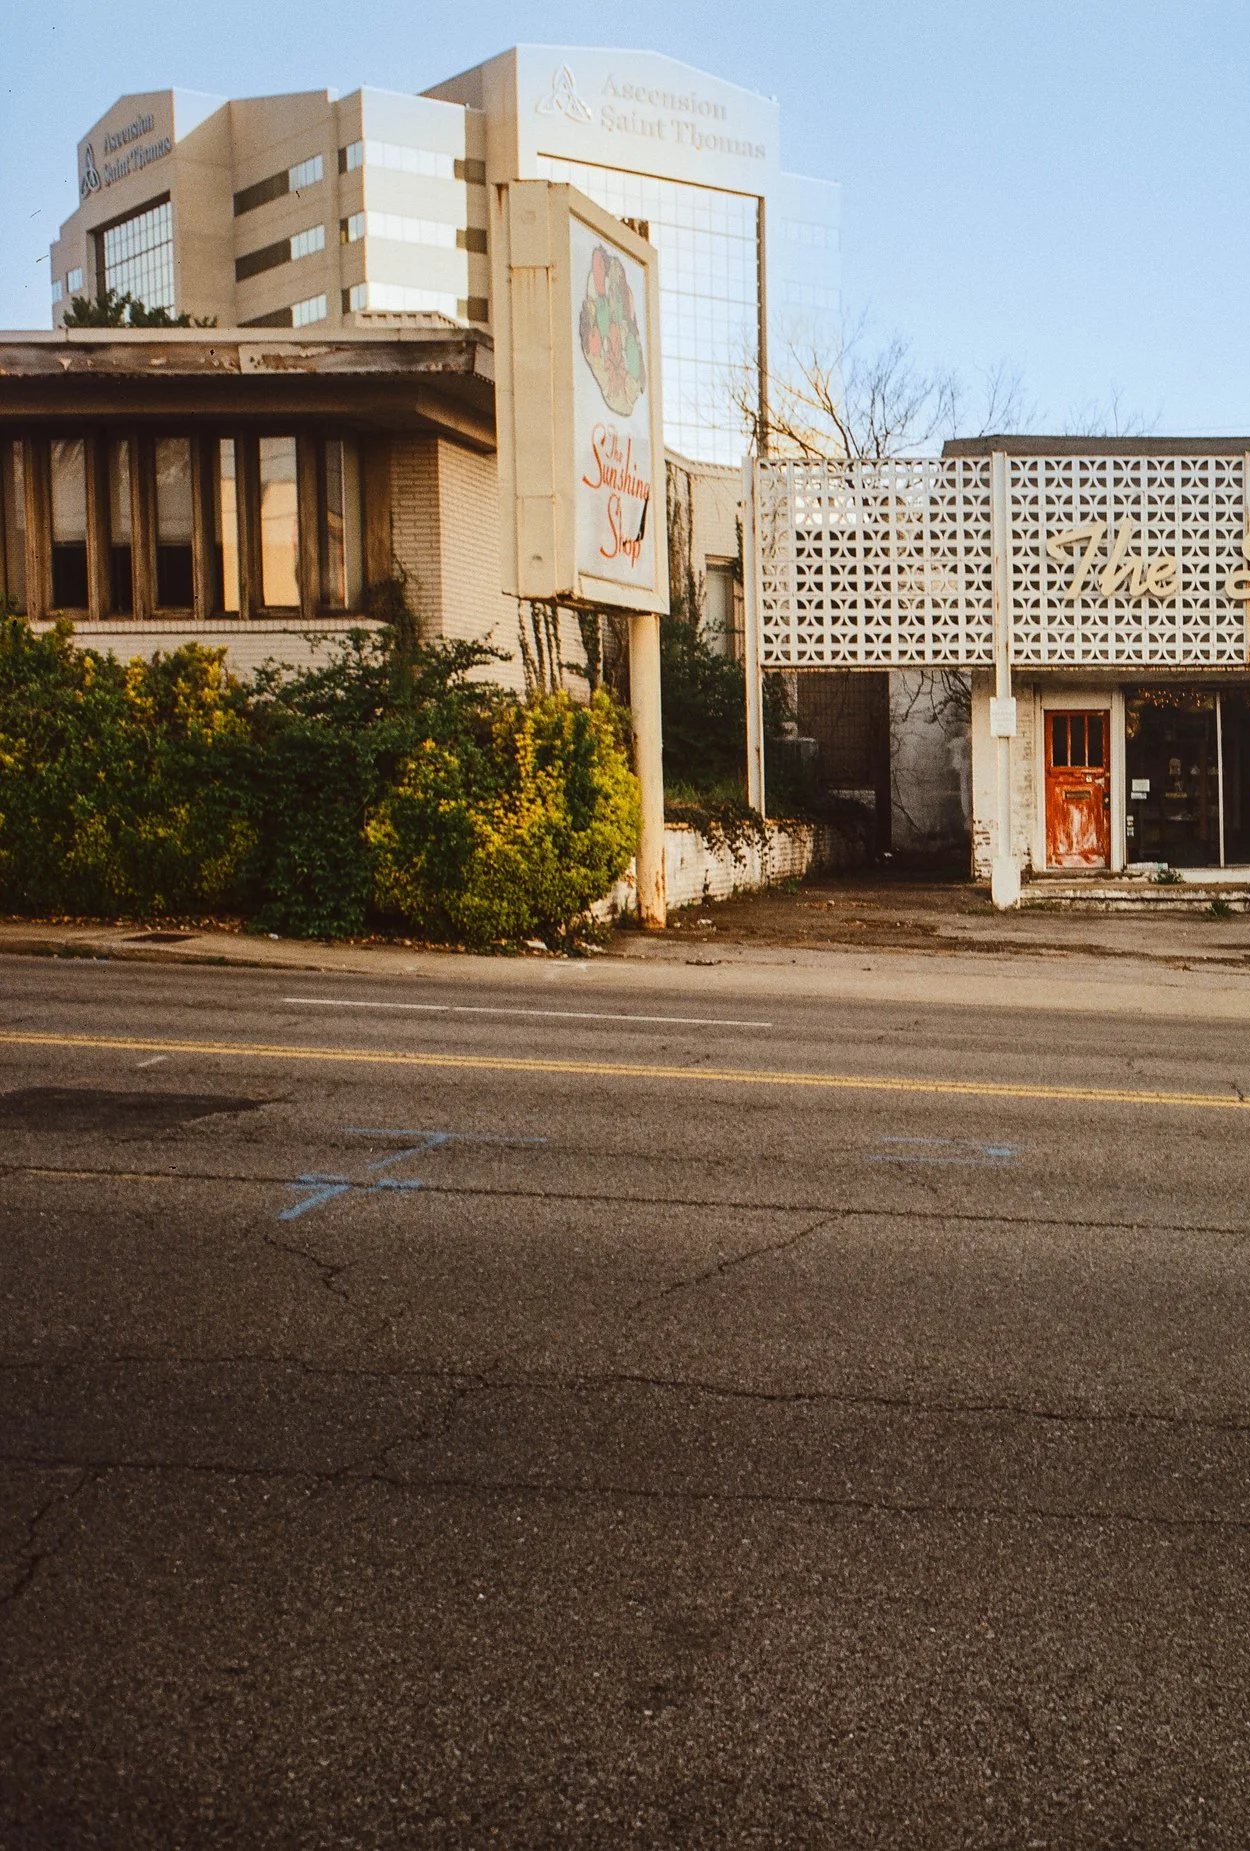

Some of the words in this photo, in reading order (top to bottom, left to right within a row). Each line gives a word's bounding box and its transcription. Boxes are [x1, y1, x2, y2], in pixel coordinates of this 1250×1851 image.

[603, 73, 727, 119] Ascension
[600, 104, 664, 139] Saint
[670, 119, 766, 158] Thomas
[600, 493, 641, 568] Shop
[1045, 517, 1179, 601] The
